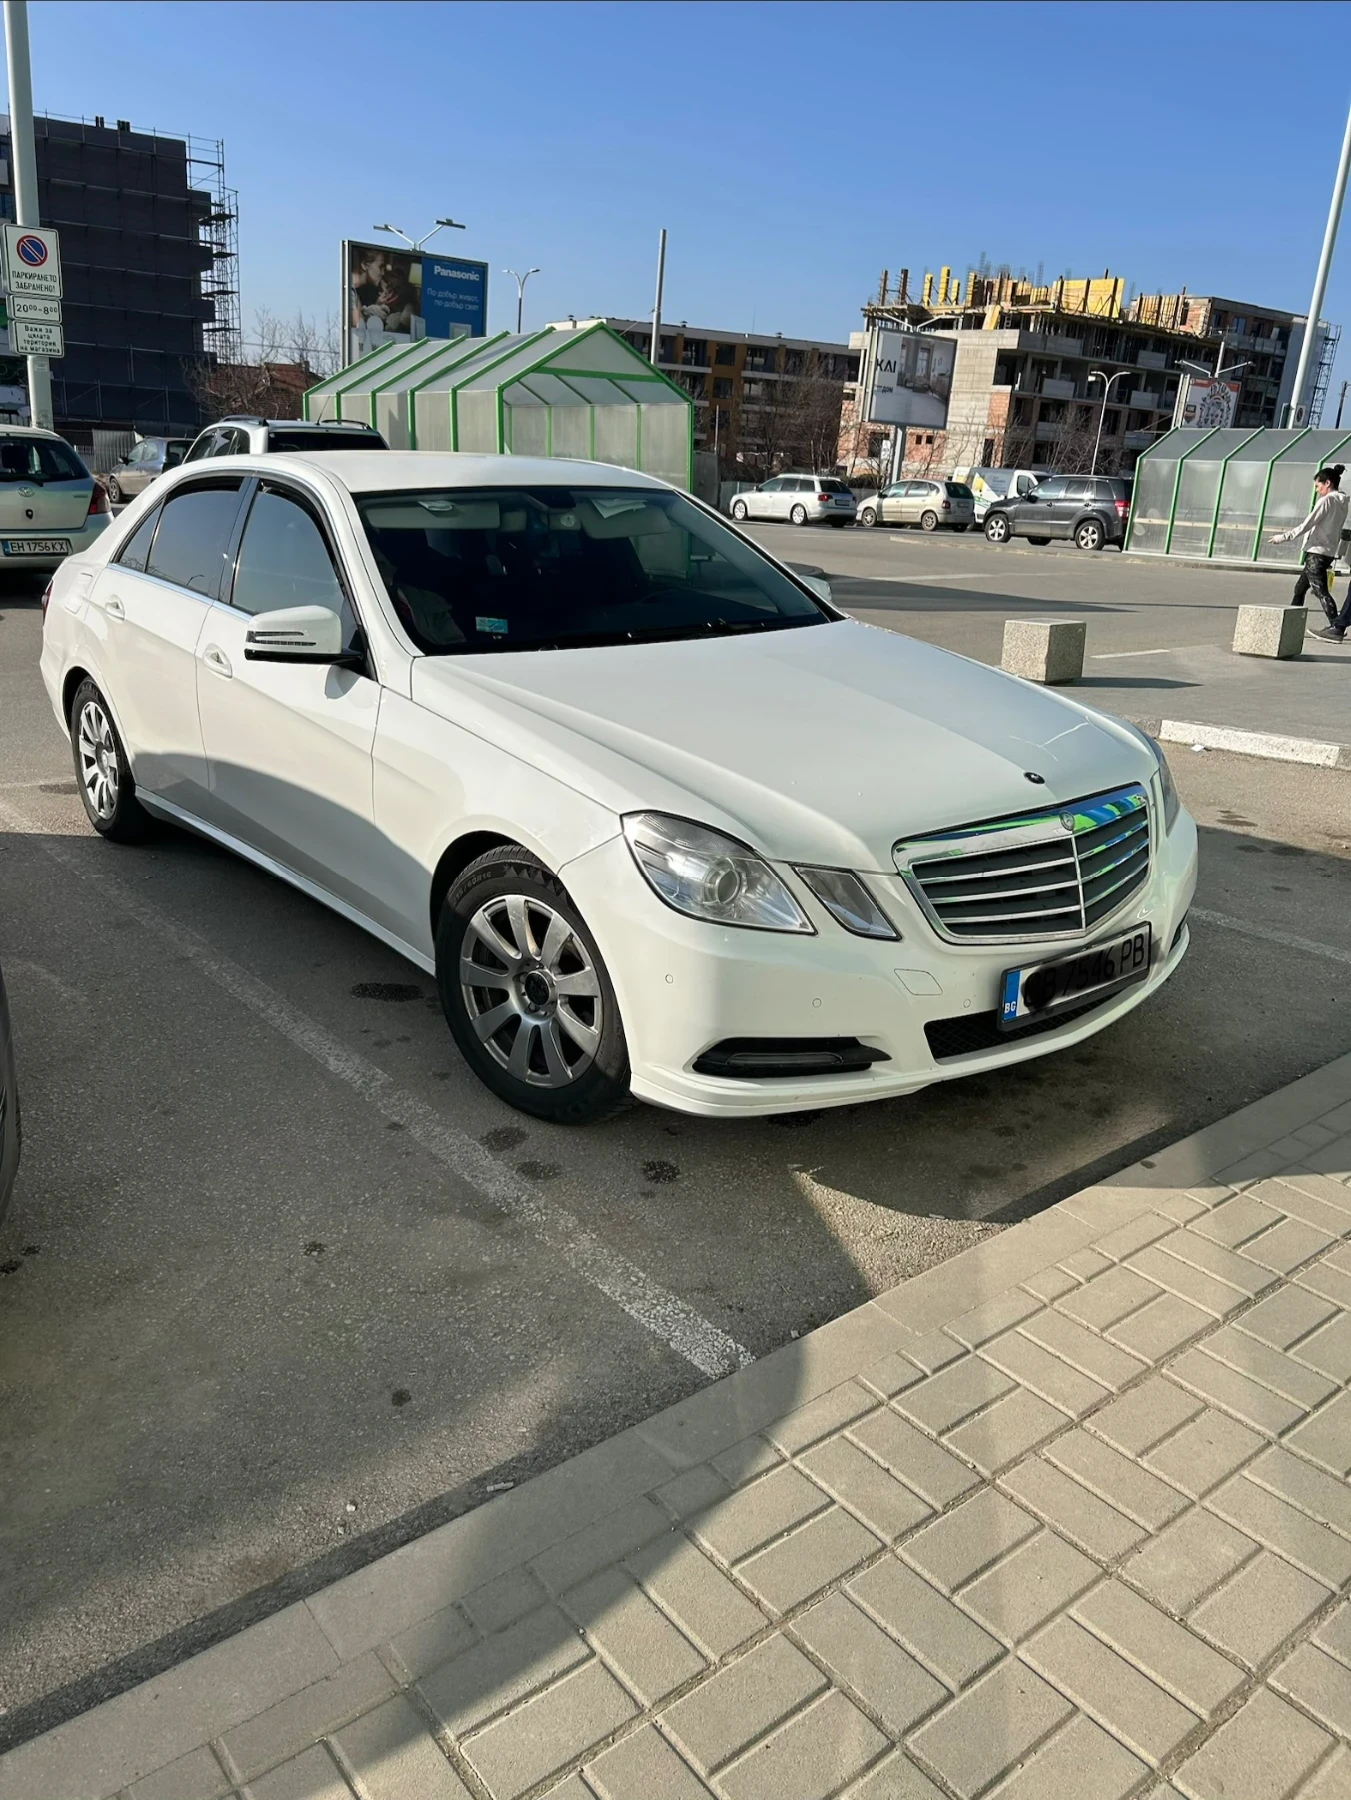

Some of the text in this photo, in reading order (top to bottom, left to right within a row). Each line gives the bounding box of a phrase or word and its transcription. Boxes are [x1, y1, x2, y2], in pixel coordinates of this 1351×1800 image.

[11, 270, 57, 283] ПАРКИРАНЕТО
[433, 265, 480, 281] Panasonic
[15, 281, 56, 293] ЗАБРАНЕНО!
[427, 287, 458, 300] По-добър
[434, 299, 464, 310] по-добър
[24, 324, 43, 333] Важи
[23, 339, 57, 347] територия
[30, 346, 60, 354] магазина
[10, 541, 66, 552] EH 1756 KX
[1062, 945, 1115, 996] 7546
[1119, 933, 1145, 973] PB
[1004, 1000, 1017, 1014] BG
